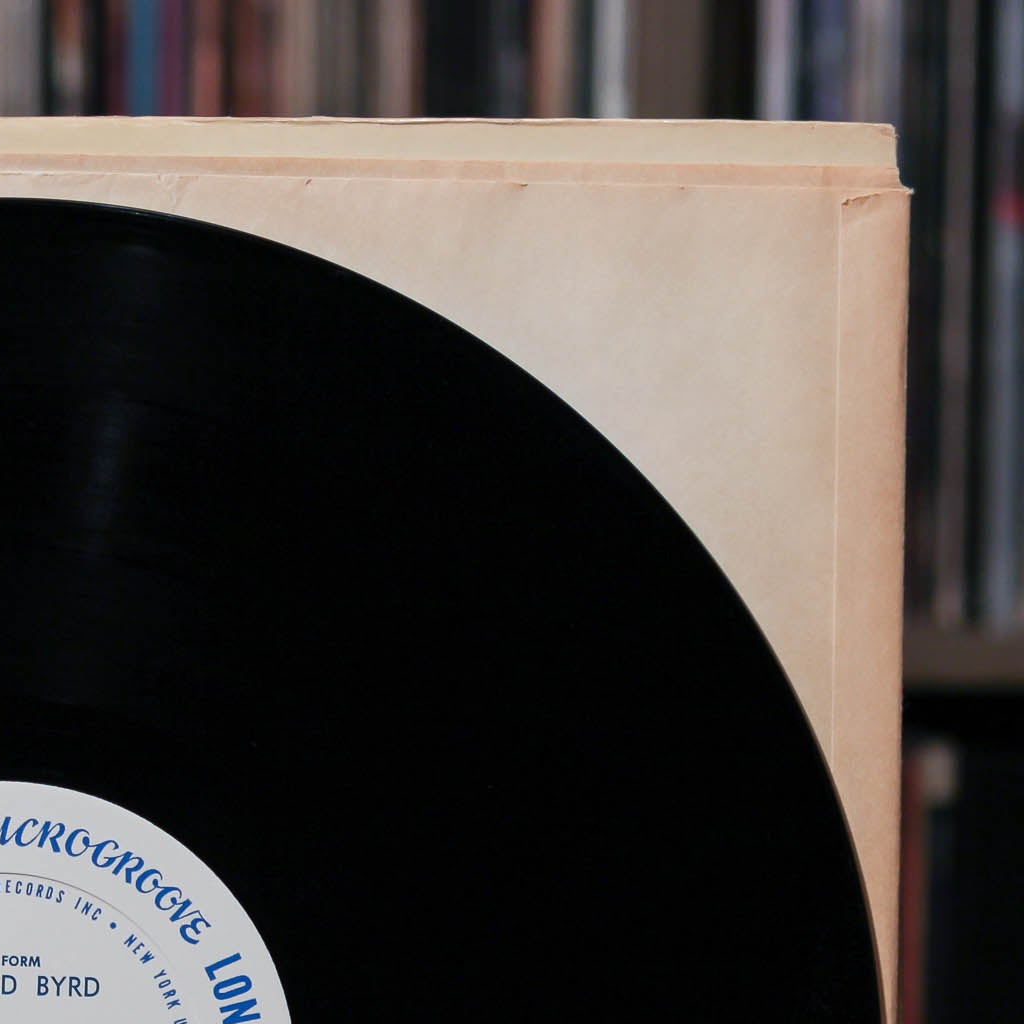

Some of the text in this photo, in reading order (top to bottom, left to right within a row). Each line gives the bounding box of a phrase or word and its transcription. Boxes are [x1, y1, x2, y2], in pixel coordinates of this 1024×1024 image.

[1, 955, 41, 968] FORM
[74, 896, 102, 921] INC
[123, 934, 154, 964] NEW
[153, 969, 181, 1010] YORK
[36, 975, 100, 998] BYRD
